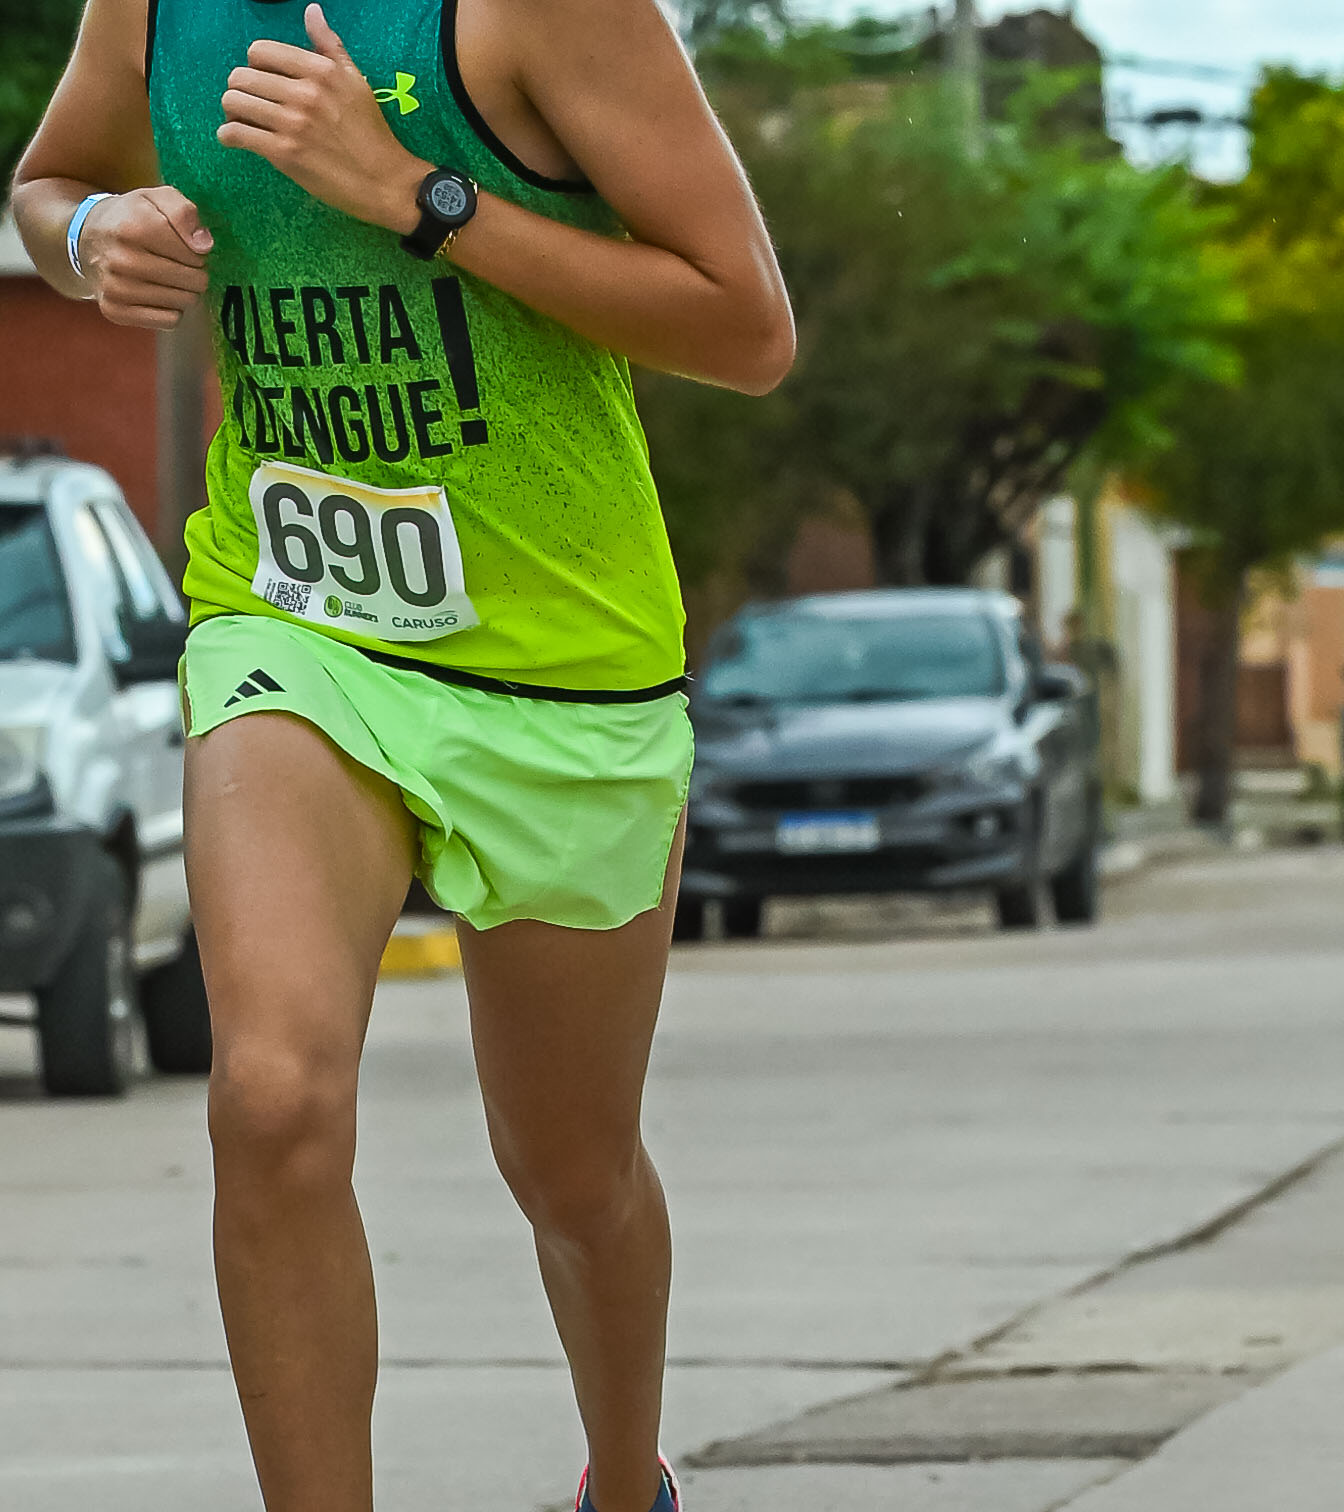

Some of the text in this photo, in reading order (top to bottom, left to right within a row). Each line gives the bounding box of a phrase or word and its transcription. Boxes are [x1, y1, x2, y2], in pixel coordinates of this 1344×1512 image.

[221, 283, 423, 368] ALERTA
[262, 482, 447, 608] 690
[391, 615, 459, 630] CARUSO
